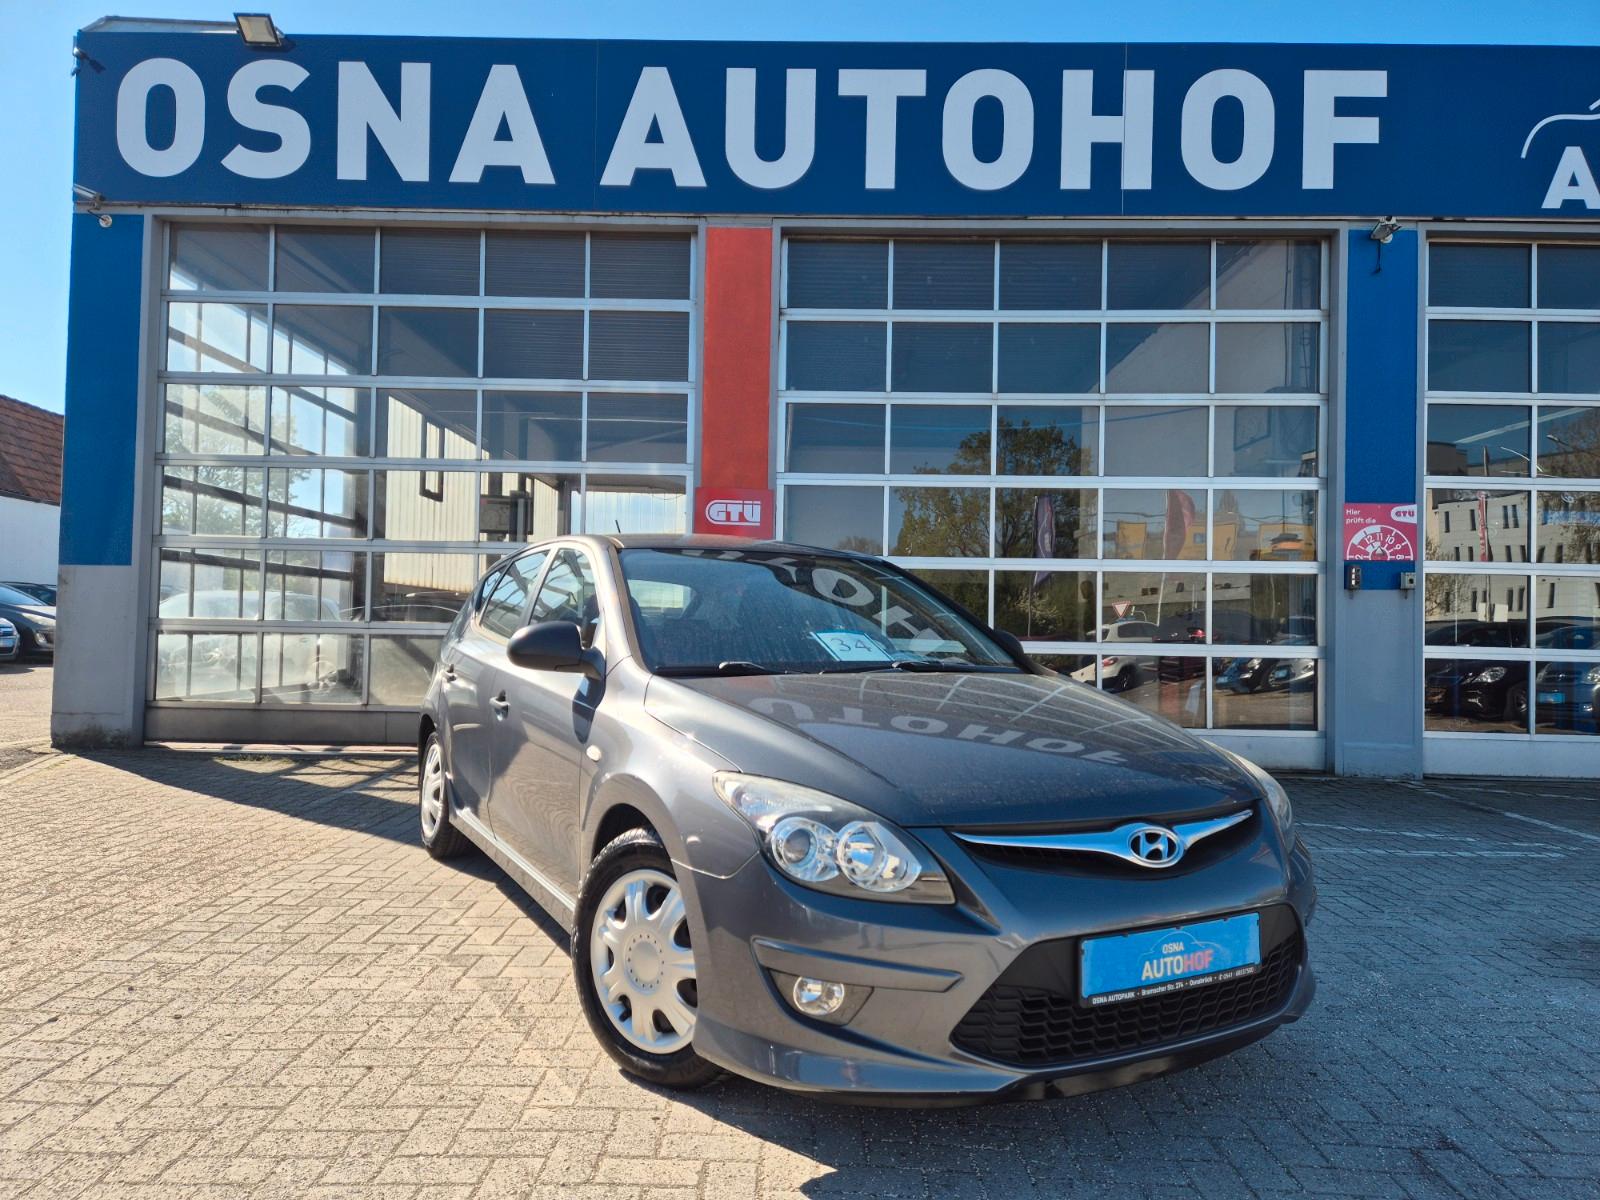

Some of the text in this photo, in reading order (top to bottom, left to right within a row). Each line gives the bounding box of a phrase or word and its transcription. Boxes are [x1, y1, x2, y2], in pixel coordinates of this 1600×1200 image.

[116, 58, 1388, 191] OSNA AUTOHOF
[1345, 508, 1361, 516] Hier
[1345, 517, 1364, 525] prüft
[1364, 535, 1374, 545] 12
[1376, 533, 1383, 541] 11
[1385, 535, 1395, 544] 10
[1162, 942, 1184, 954] OSNA
[1141, 949, 1214, 981] AUTOHOF
[1092, 996, 1107, 1005] OSNA
